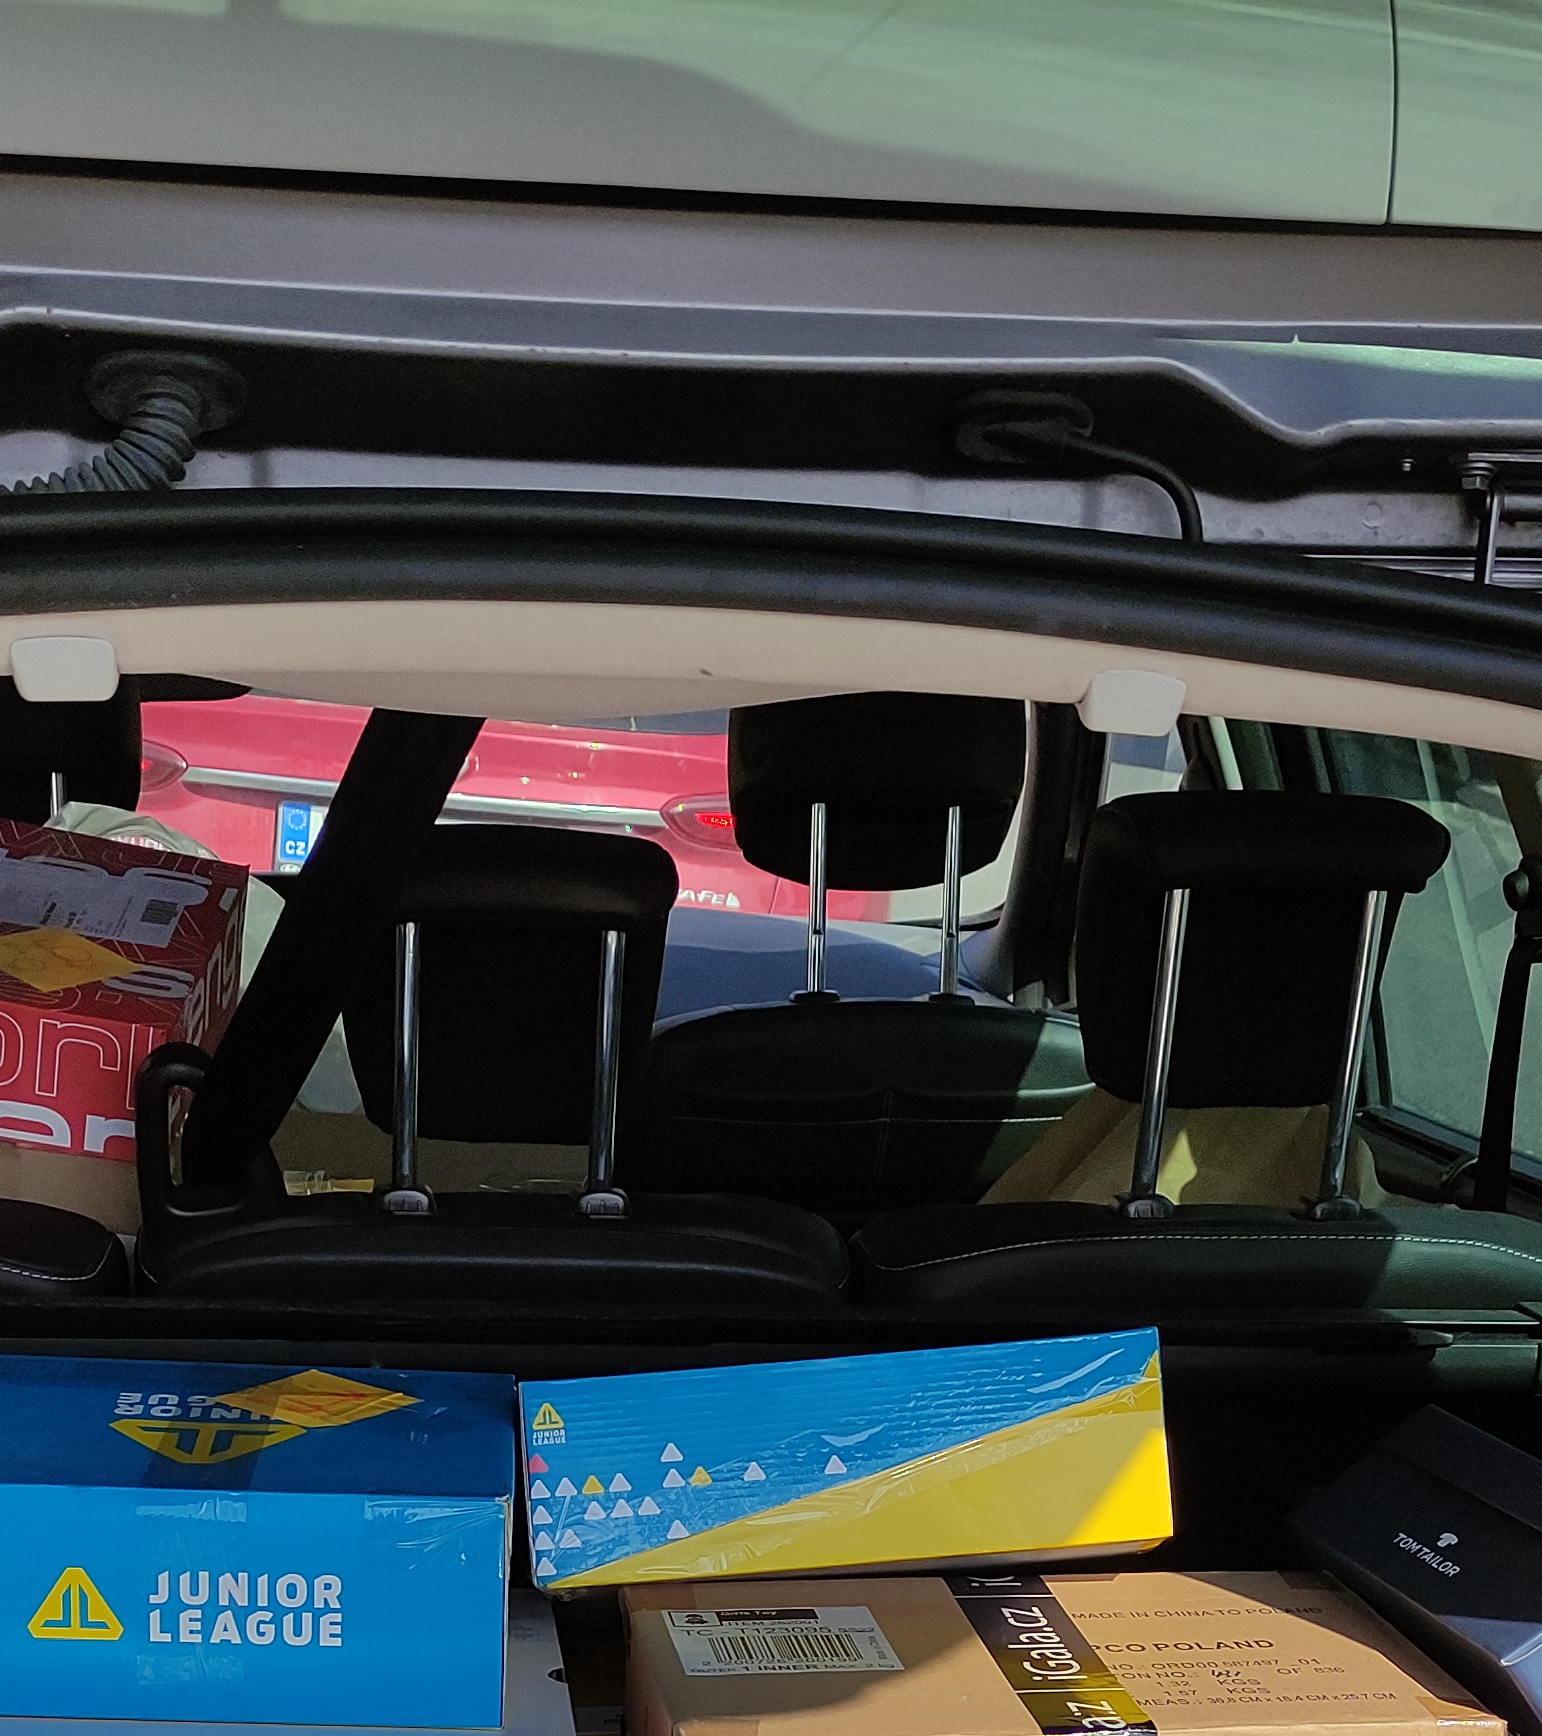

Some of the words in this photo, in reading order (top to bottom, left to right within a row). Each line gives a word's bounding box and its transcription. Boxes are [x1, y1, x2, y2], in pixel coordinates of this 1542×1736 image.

[285, 840, 306, 856] CZ
[533, 1429, 566, 1439] JUNIOR
[532, 1436, 566, 1446] LEAGUE
[148, 1569, 344, 1610] JUNIOR
[1154, 1610, 1214, 1618] CHINA
[1245, 1607, 1322, 1615] POLAND
[148, 1608, 344, 1648] LEAGUE
[680, 1629, 714, 1637] TC
[1004, 1604, 1089, 1682] iGala.cz
[1152, 1640, 1274, 1652] POLAND
